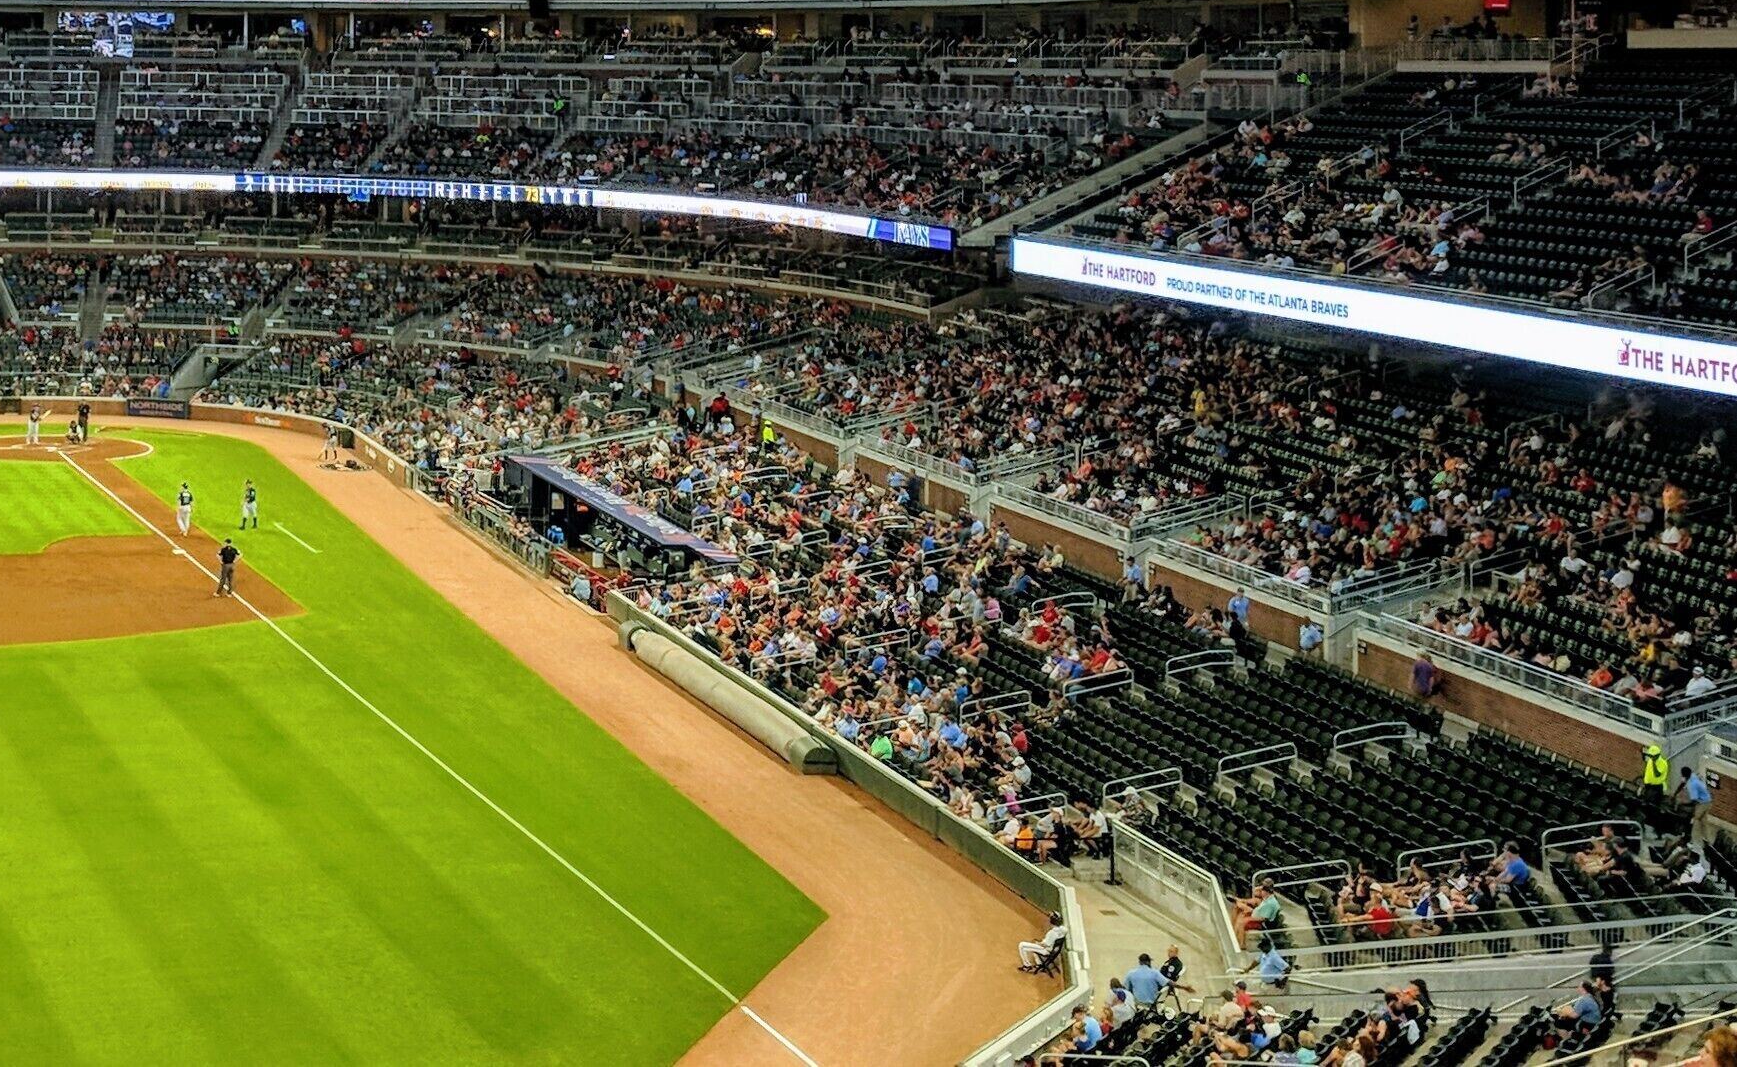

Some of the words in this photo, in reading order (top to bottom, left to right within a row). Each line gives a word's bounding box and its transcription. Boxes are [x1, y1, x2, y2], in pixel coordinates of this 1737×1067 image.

[1088, 262, 1103, 278] THE
[1106, 265, 1156, 286] HARTFORD
[1167, 277, 1194, 293] PROUD
[1195, 281, 1233, 300] PARTNER
[1235, 288, 1247, 301] OF
[1249, 290, 1266, 305] THE
[1268, 293, 1309, 312] ATLANTA
[1311, 300, 1349, 319] BRAVES
[1631, 348, 1663, 372] THE
